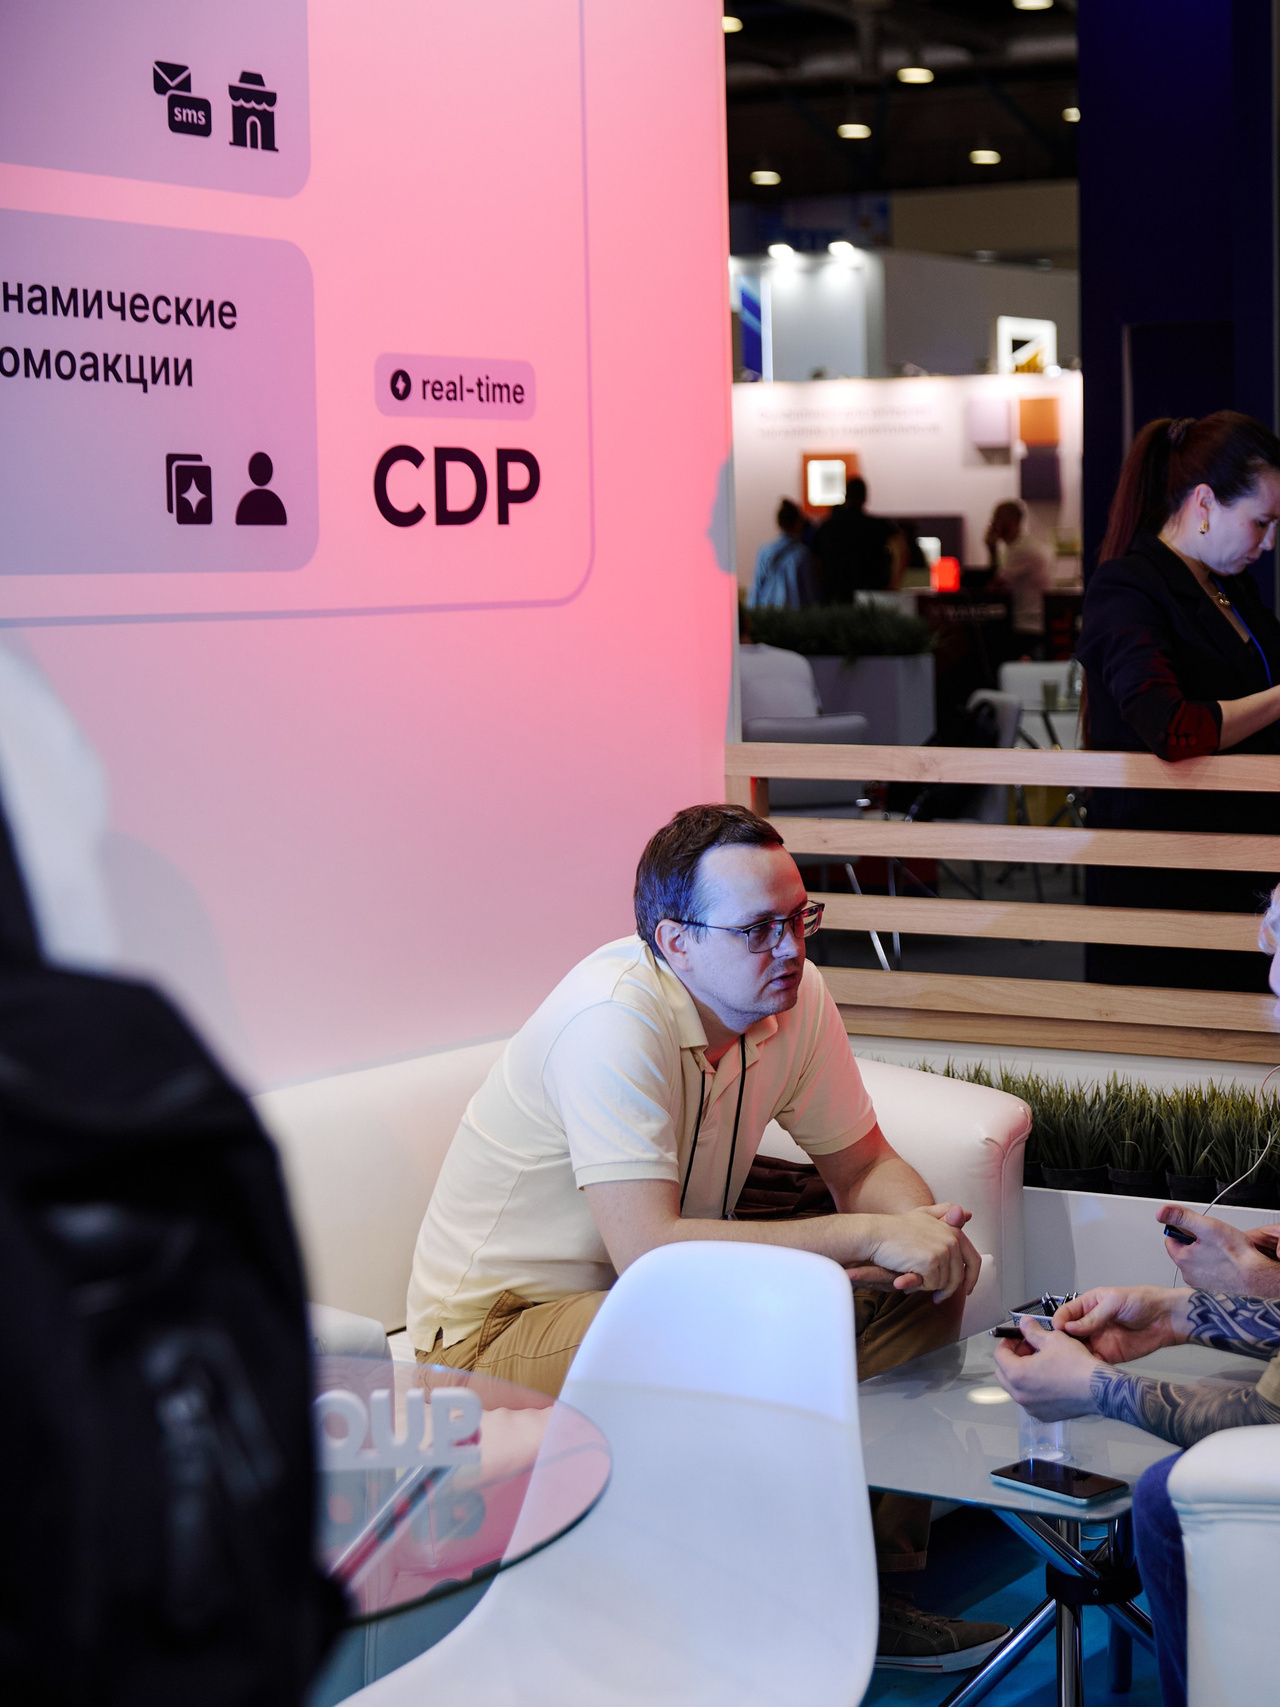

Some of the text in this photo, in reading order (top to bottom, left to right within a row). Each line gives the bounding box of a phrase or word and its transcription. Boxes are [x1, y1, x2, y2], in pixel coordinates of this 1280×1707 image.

[173, 106, 206, 126] sms
[2, 280, 238, 330] намические
[0, 345, 193, 393] омоакции
[421, 374, 526, 406] real-time
[373, 444, 541, 528] CDP
